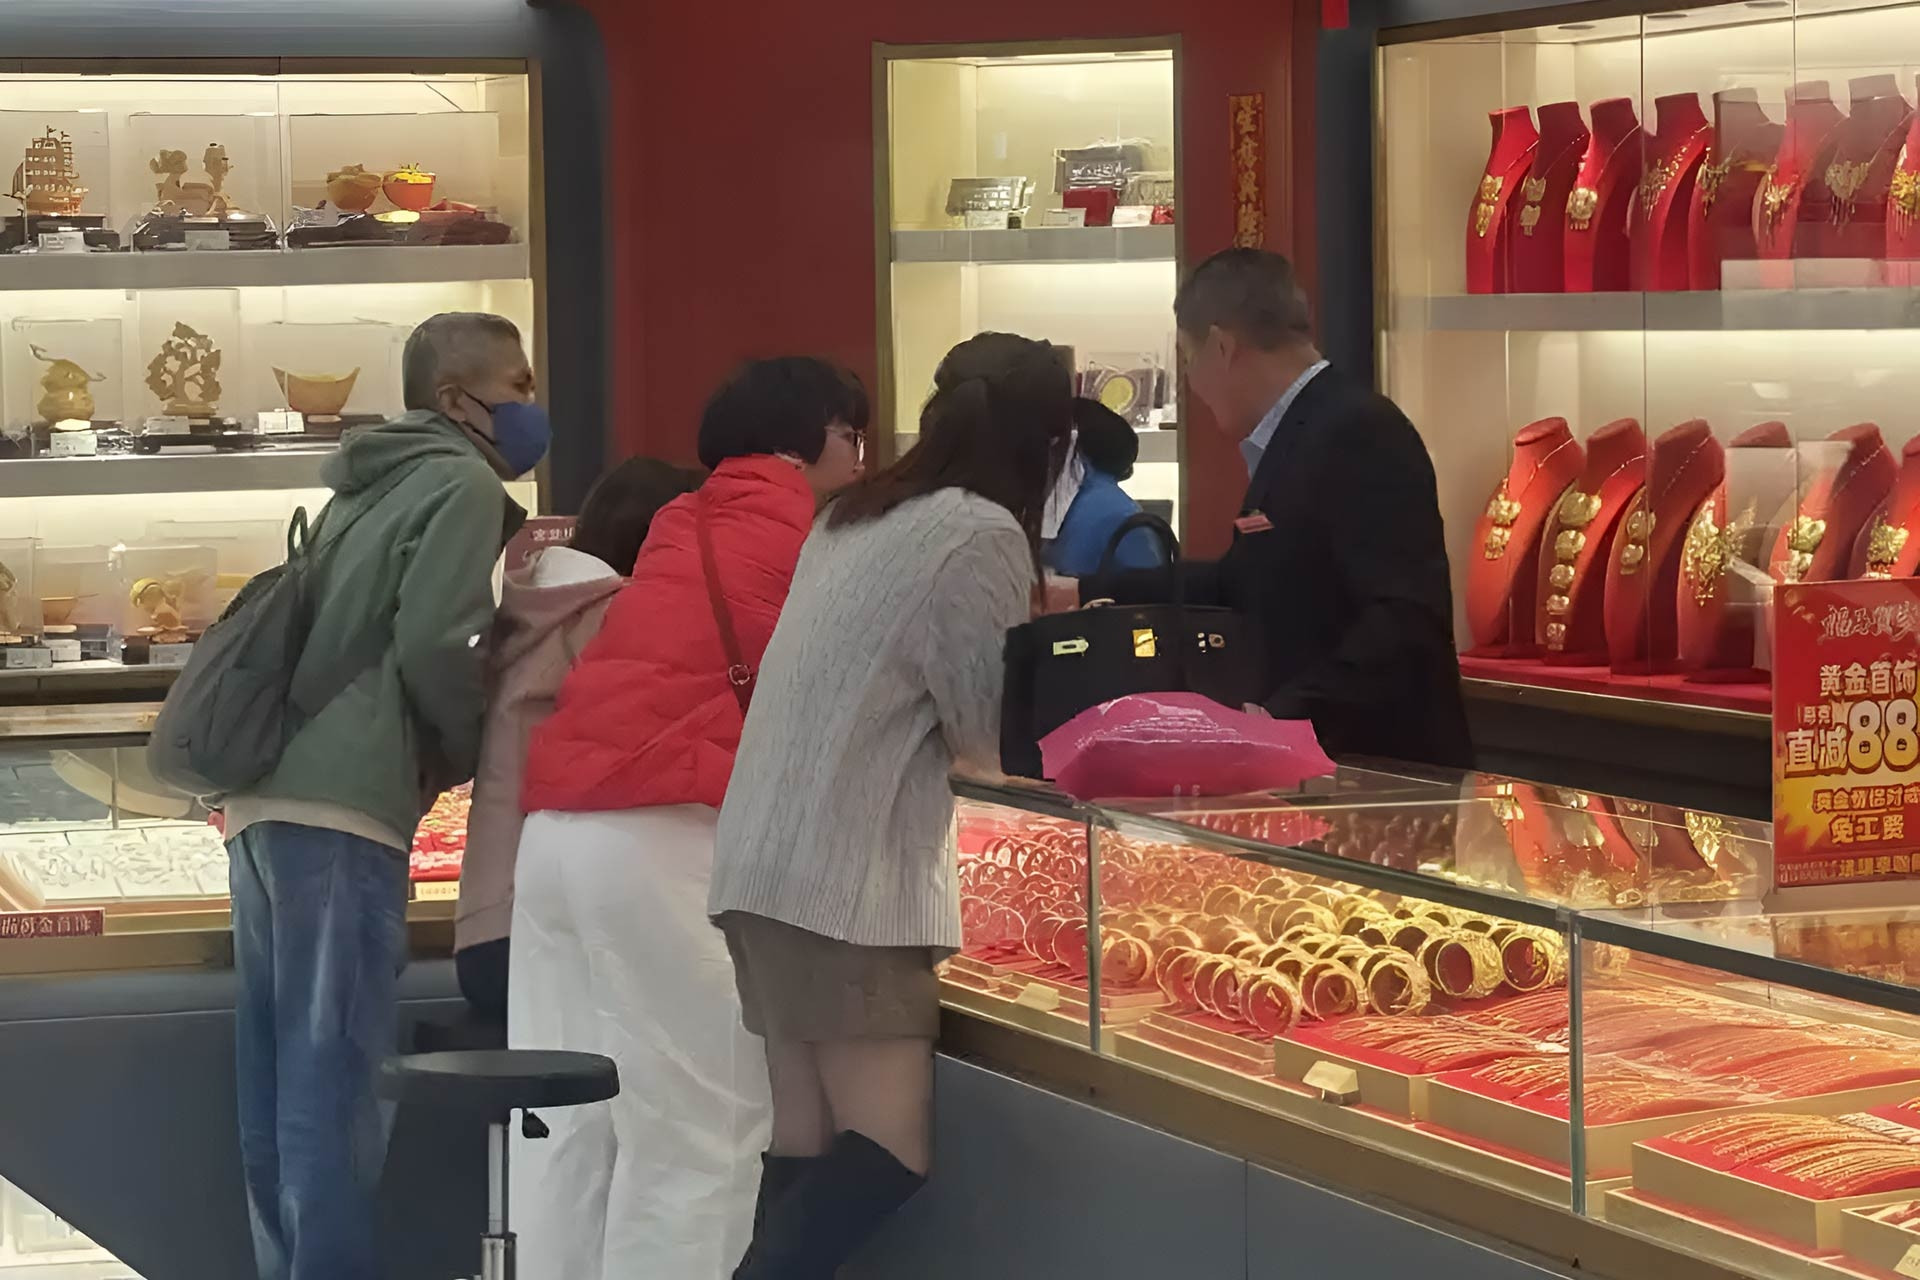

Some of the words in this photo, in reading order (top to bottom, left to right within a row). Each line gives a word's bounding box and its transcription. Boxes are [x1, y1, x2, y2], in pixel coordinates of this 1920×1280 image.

[1820, 660, 1917, 697] 黄金首饰
[1848, 699, 1920, 770] 88
[1831, 814, 1905, 844] 免工费
